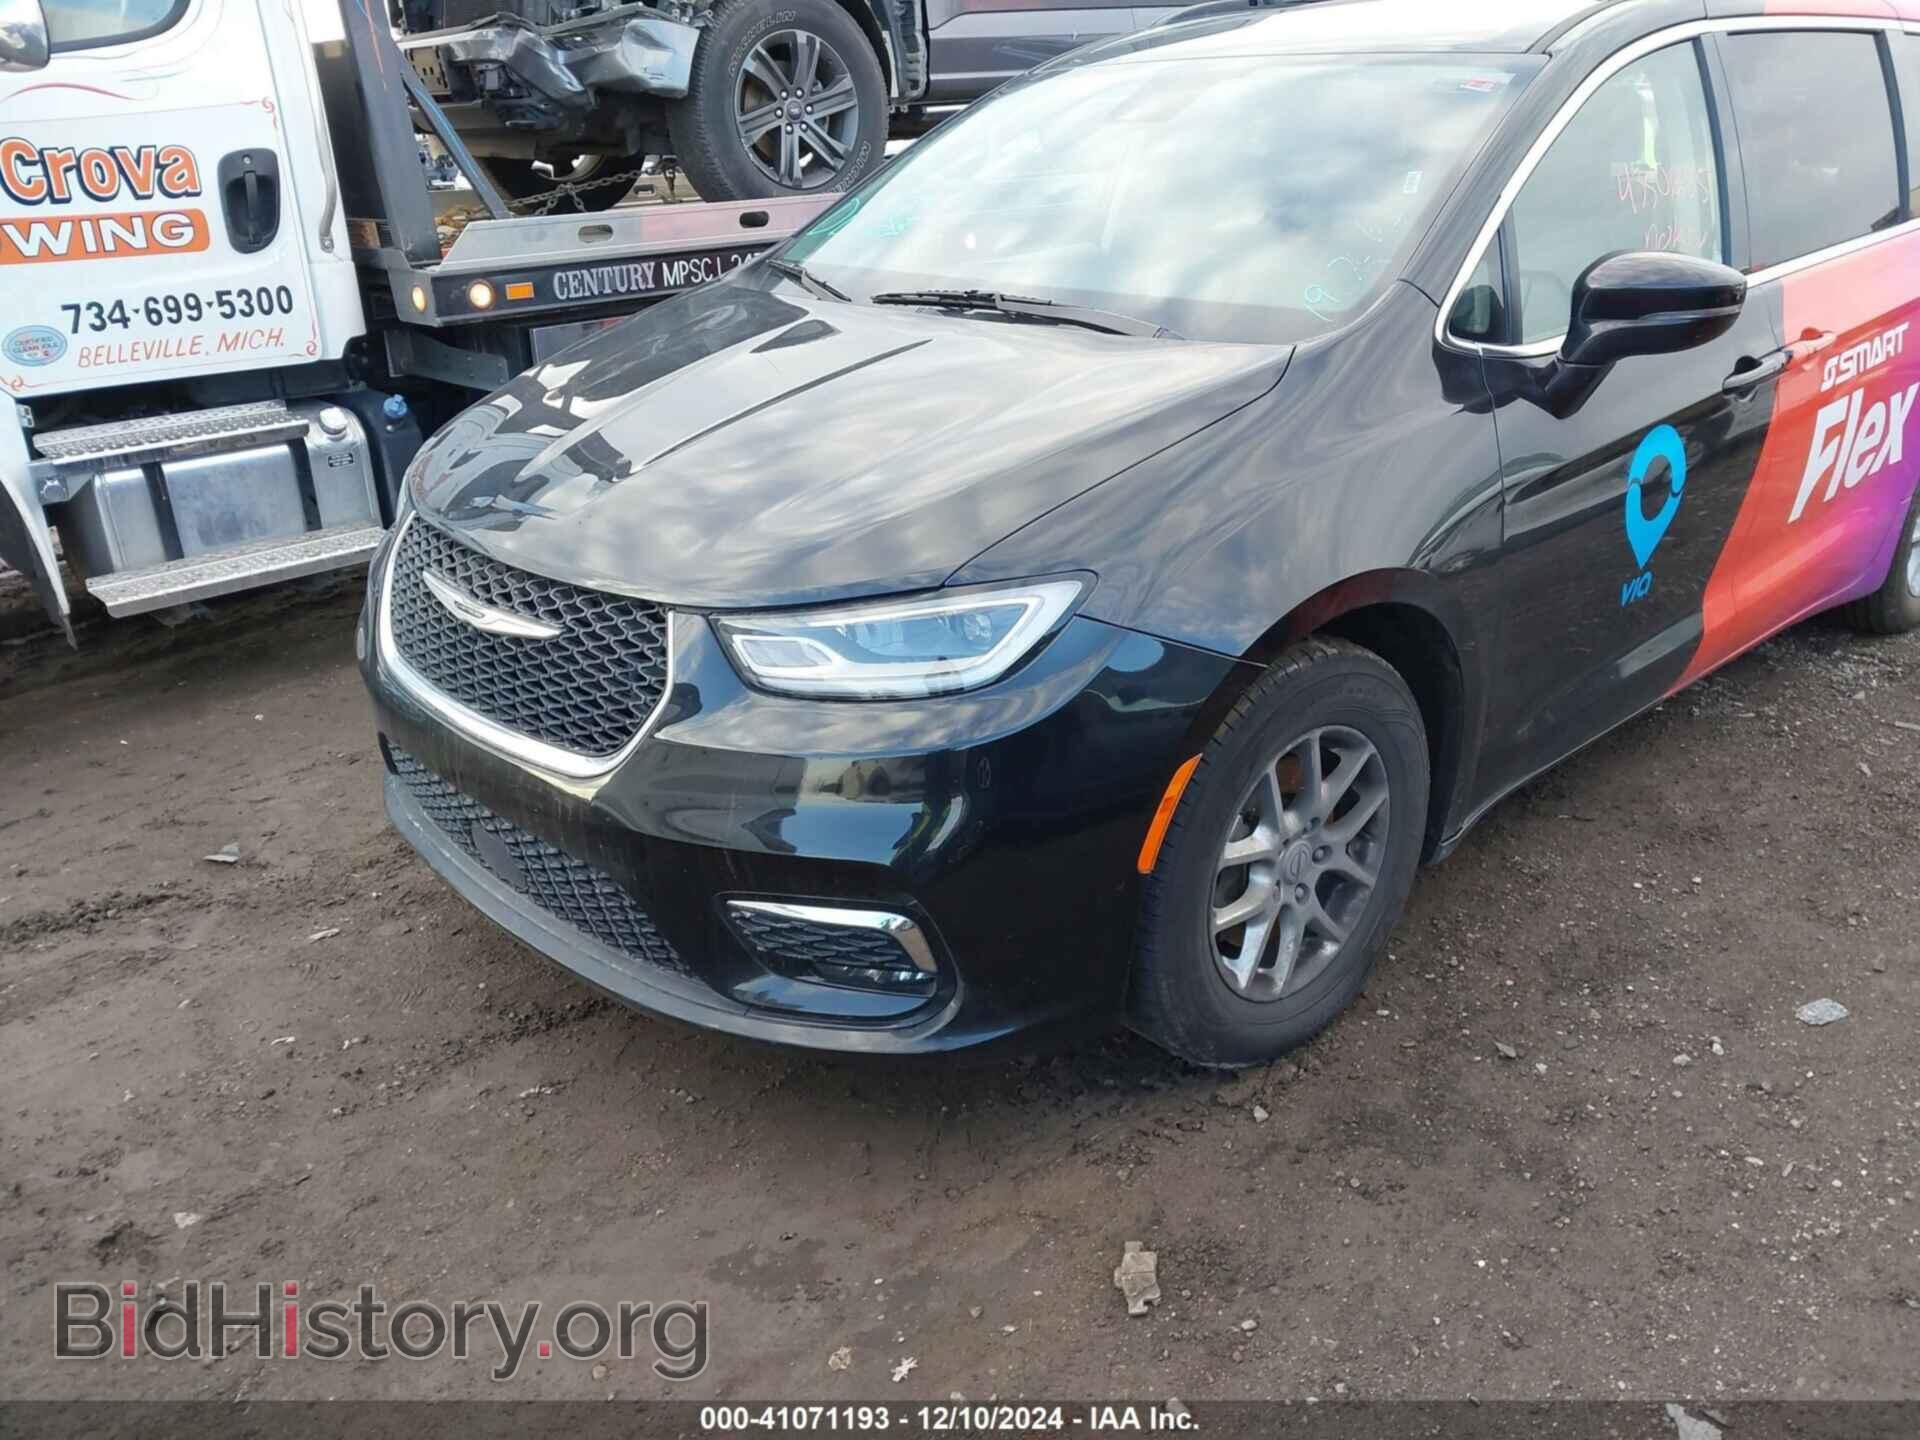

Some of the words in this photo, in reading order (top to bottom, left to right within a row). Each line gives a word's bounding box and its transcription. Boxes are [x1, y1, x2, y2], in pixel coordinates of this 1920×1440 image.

[0, 137, 201, 206] Crova
[553, 261, 656, 300] CENTURY
[662, 258, 713, 288] MPSC
[216, 327, 285, 353] MICH.
[1787, 382, 1920, 524] Flex
